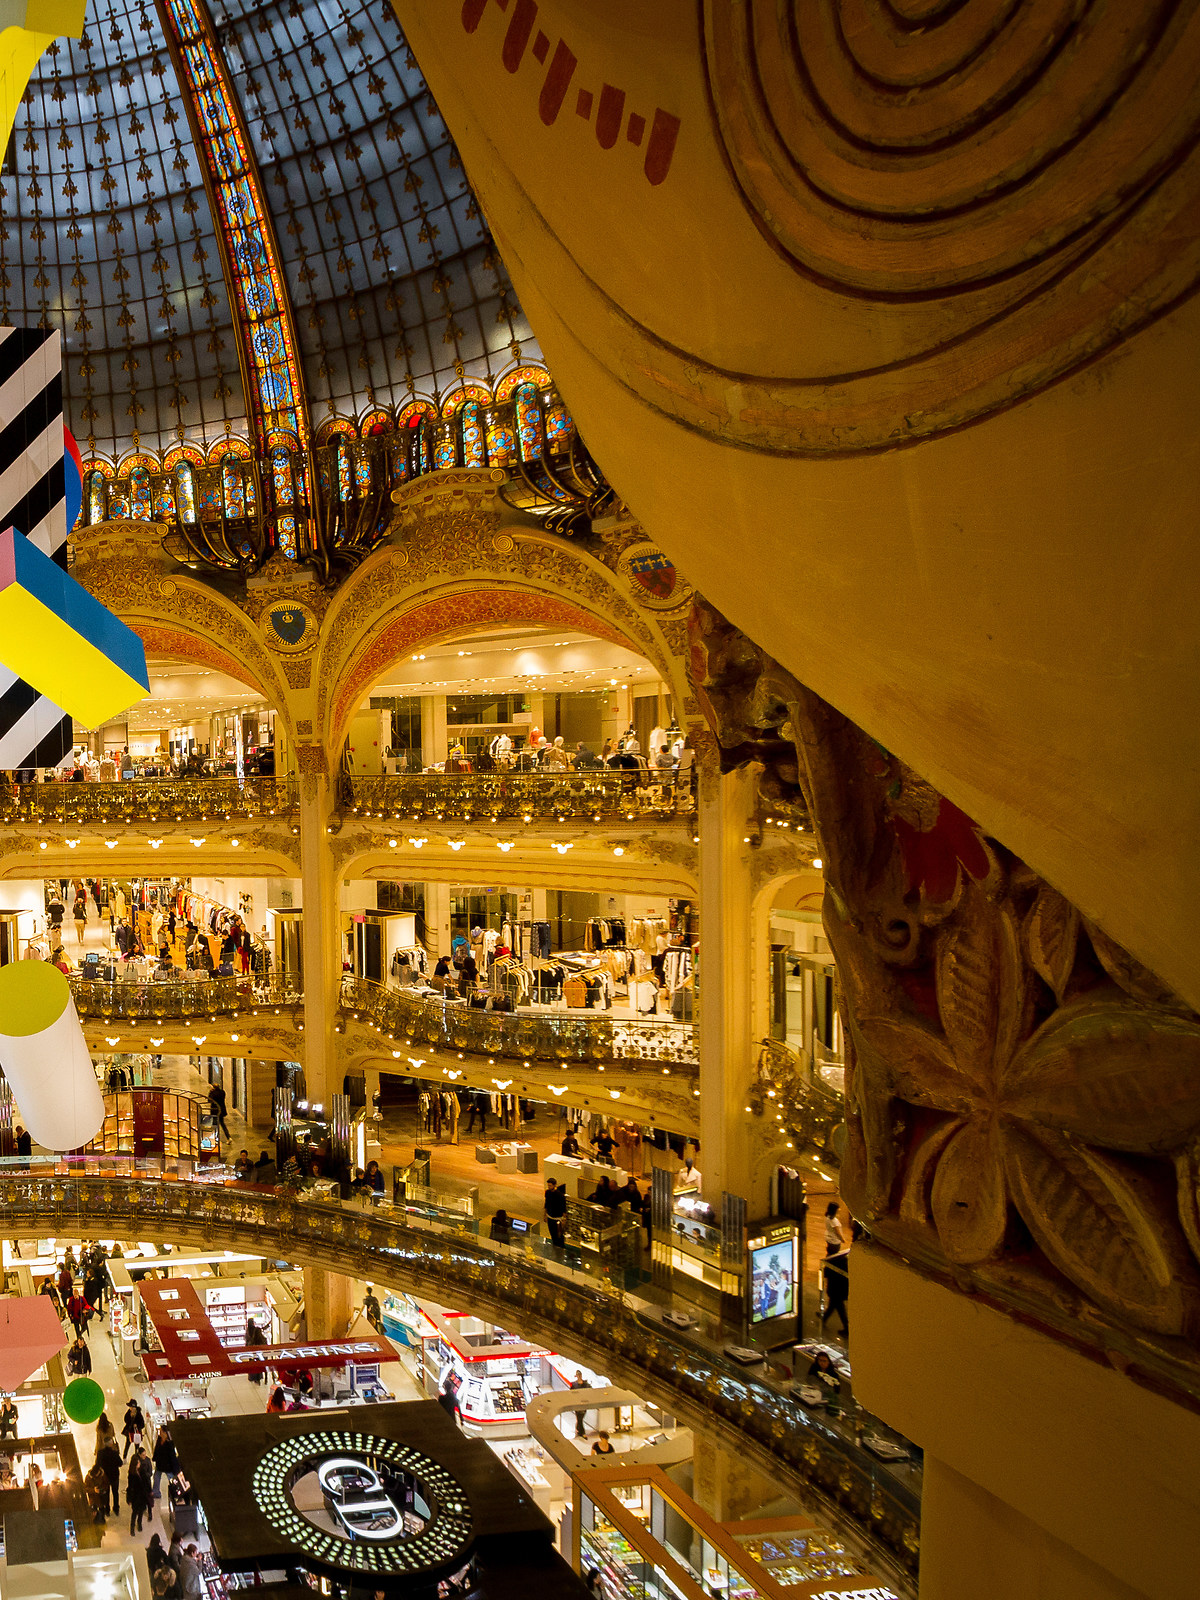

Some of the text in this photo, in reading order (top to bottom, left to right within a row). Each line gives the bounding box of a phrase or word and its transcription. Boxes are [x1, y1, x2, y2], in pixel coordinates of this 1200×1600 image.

[770, 1226, 791, 1237] VERTU
[235, 1342, 380, 1363] CLARINS
[188, 1371, 222, 1379] CLARINS
